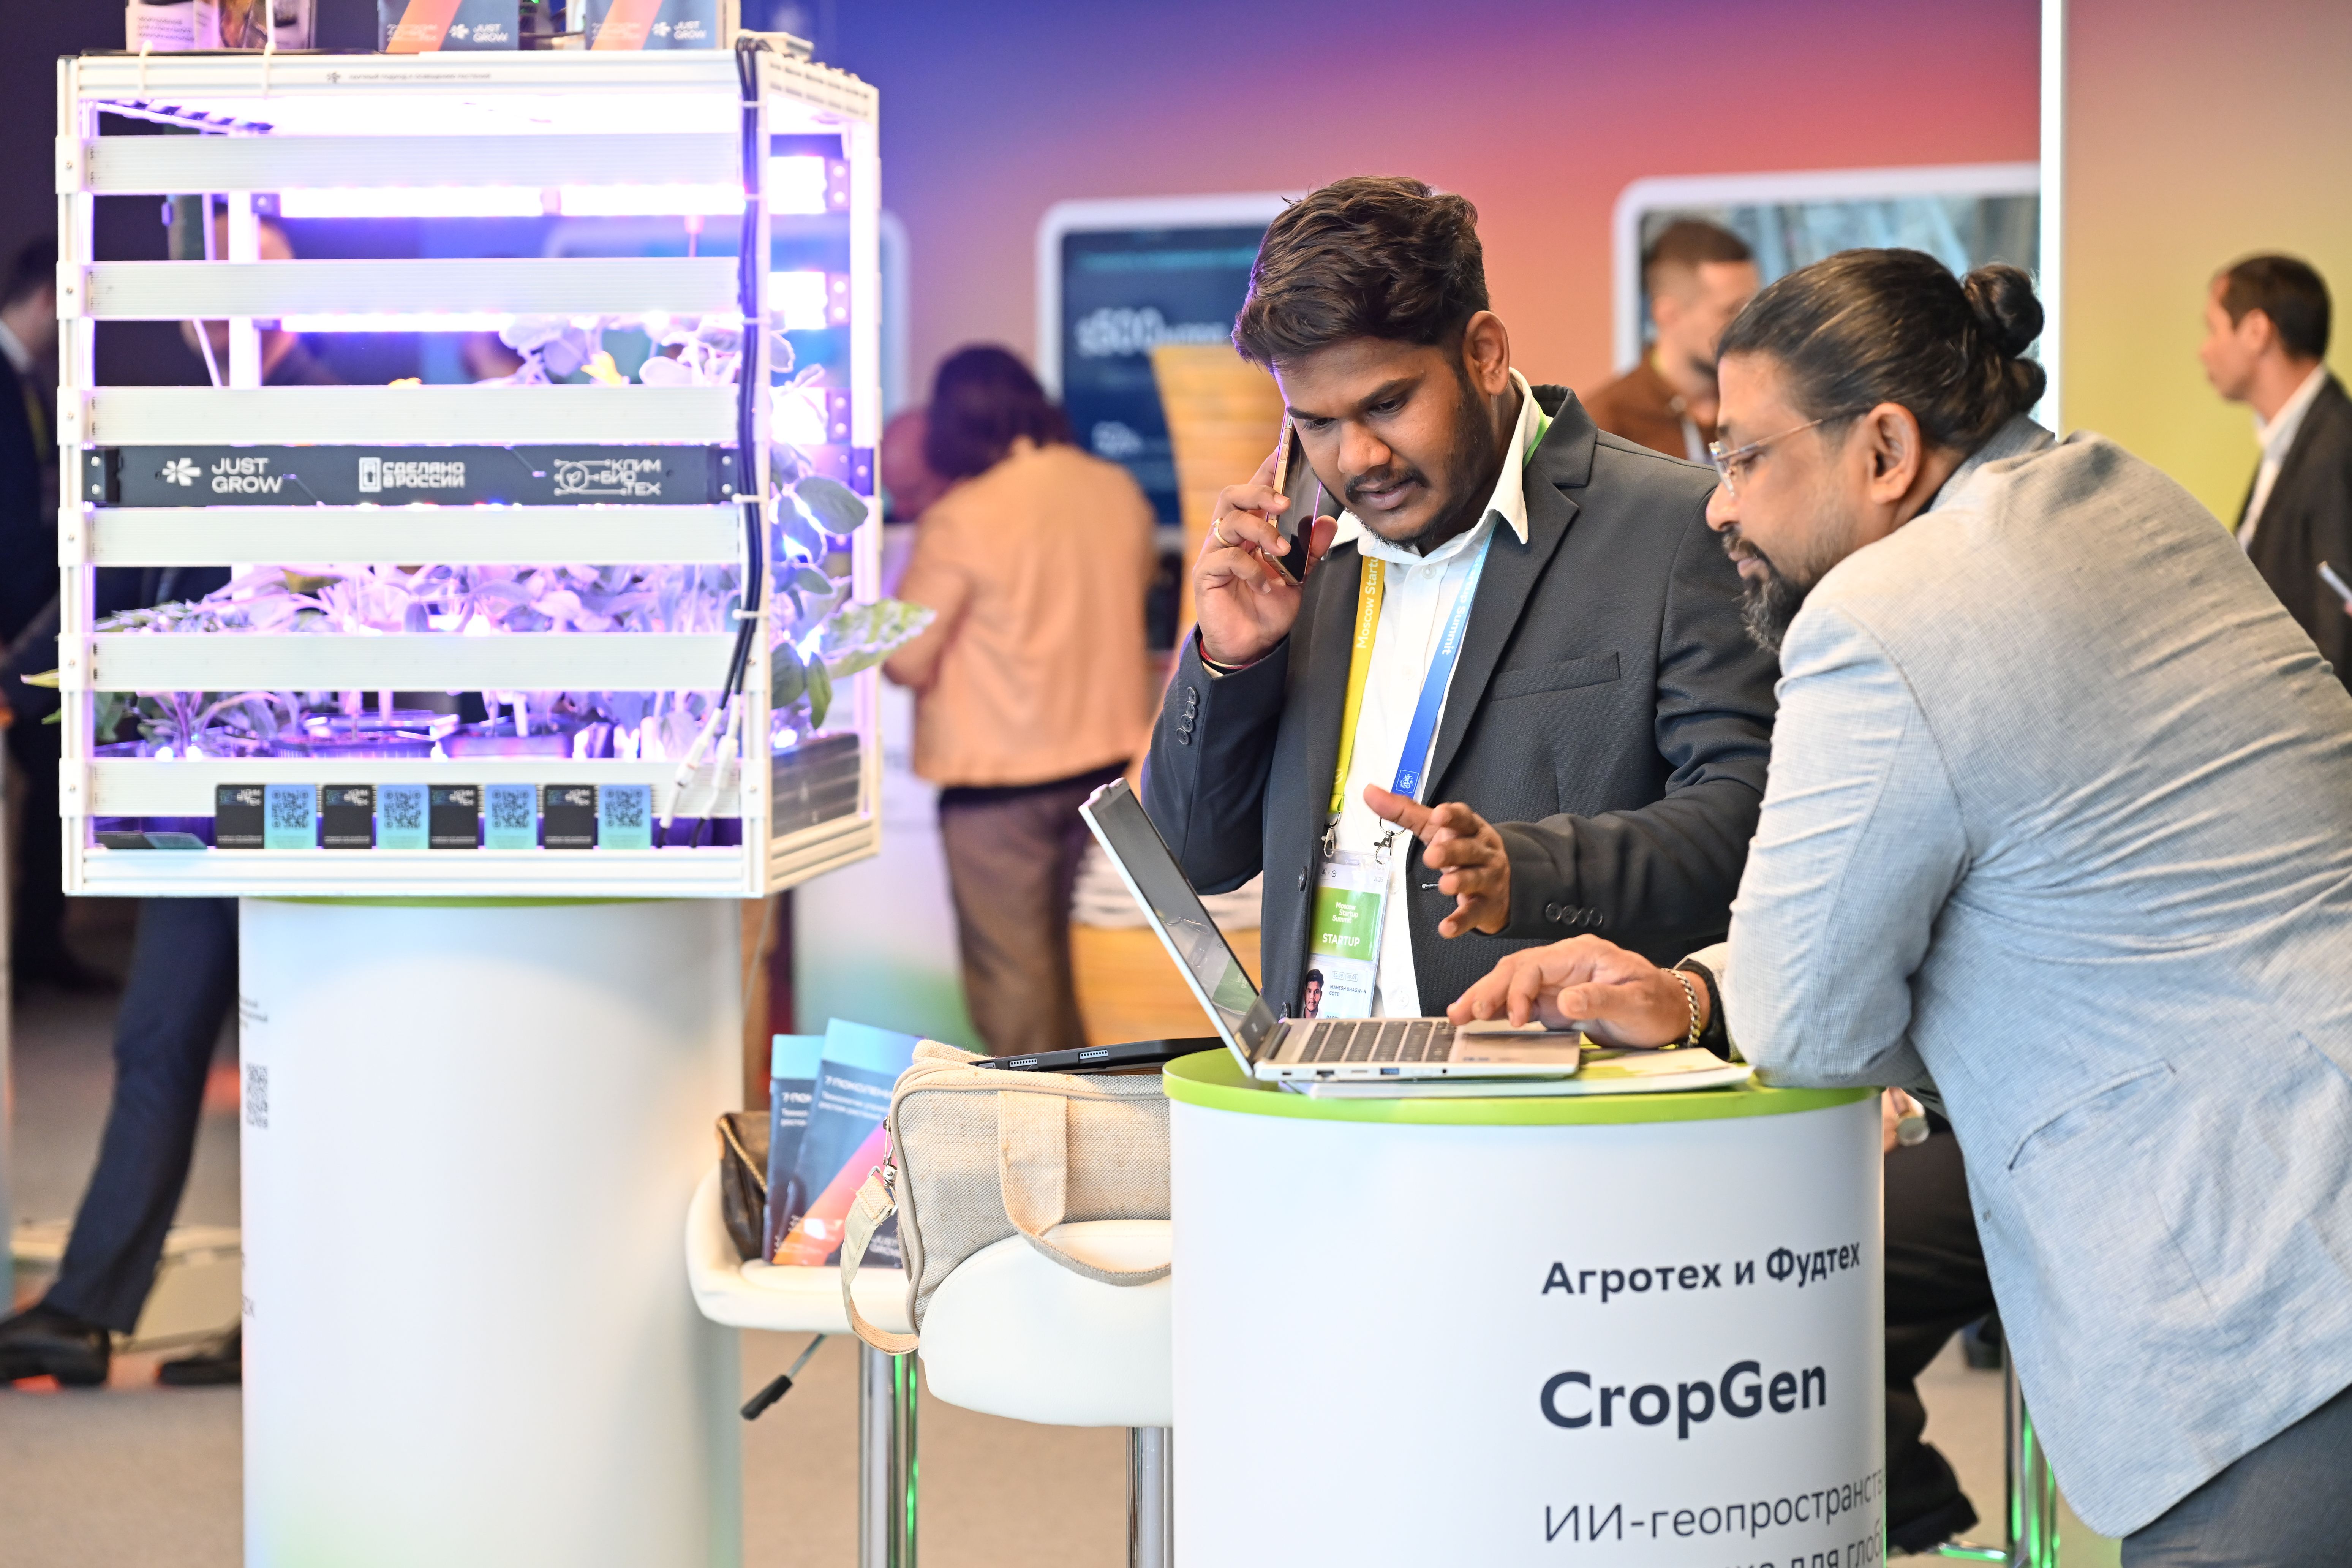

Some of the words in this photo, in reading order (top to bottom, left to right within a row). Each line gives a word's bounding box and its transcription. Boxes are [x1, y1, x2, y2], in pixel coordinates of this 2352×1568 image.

[211, 457, 270, 475] JUST
[383, 461, 465, 475] СДЕЛАНО
[212, 476, 283, 493] GROW
[1459, 554, 1482, 604] Startup
[1356, 597, 1374, 648] Moscow
[1442, 605, 1466, 655] Summit
[1336, 901, 1356, 910] Moscow
[1339, 909, 1359, 919] Startup
[1332, 915, 1352, 923] Summit
[1322, 933, 1360, 947] STARTUP
[1541, 1261, 1722, 1304] Агротех
[1734, 1260, 1755, 1286] и
[1766, 1242, 1860, 1288] Фудтех
[1540, 1359, 1826, 1440] CropGen
